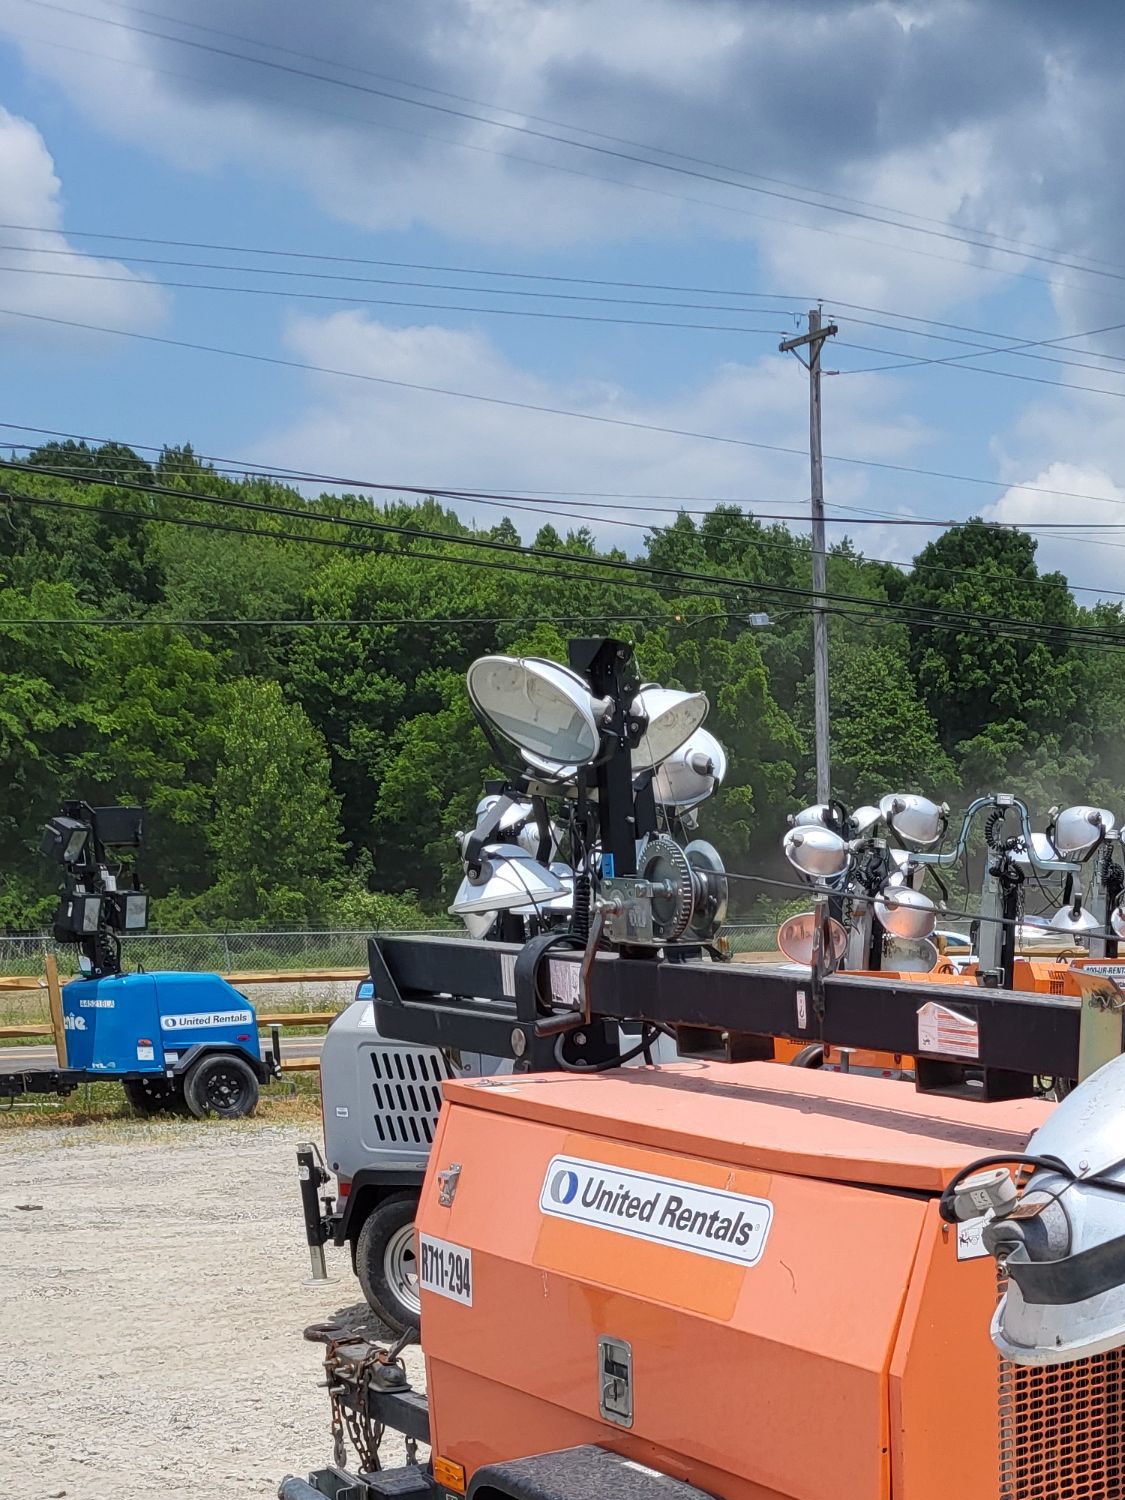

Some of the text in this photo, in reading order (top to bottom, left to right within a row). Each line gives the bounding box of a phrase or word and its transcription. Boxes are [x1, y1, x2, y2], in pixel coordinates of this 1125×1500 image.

[179, 1013, 247, 1026] United Rentals
[581, 1176, 753, 1247] United Rentals
[421, 1242, 470, 1298] R711-294
